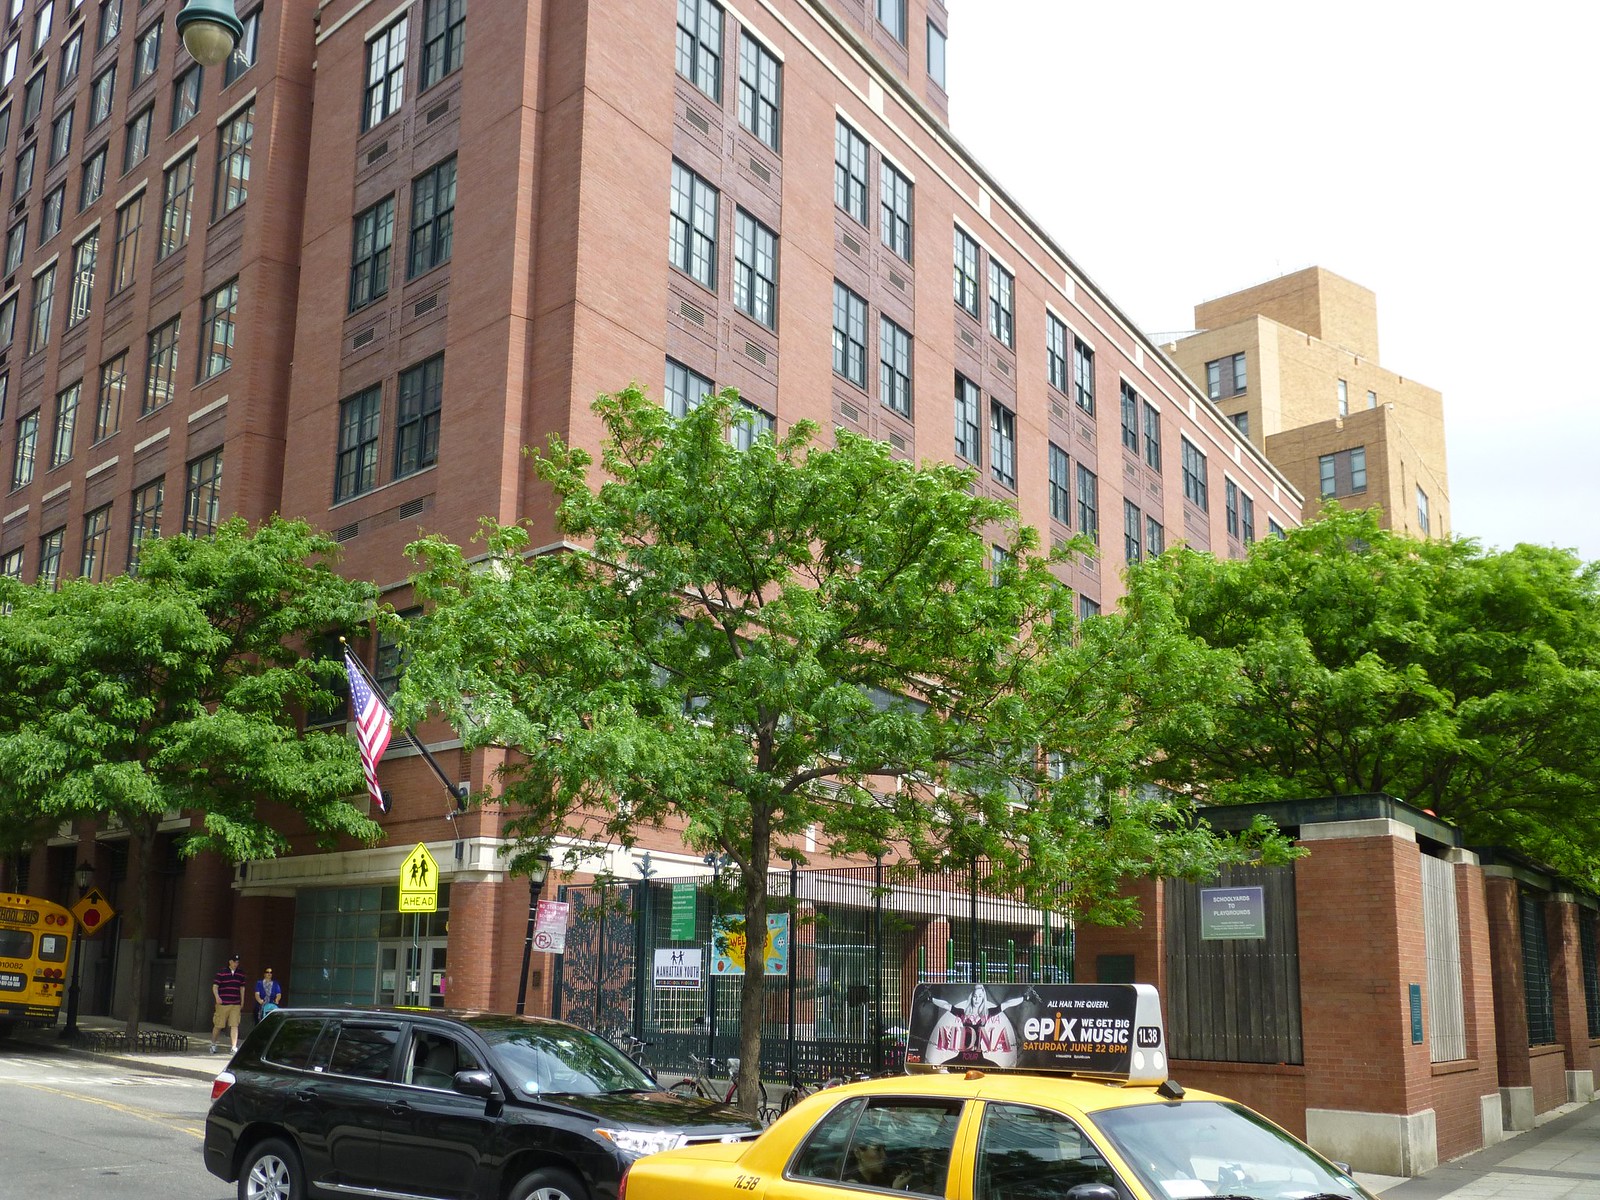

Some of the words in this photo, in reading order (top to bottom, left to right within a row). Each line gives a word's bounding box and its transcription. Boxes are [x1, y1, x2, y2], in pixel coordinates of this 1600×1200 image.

[403, 897, 434, 906] AHEAD
[0, 908, 18, 921] HOOL
[23, 910, 38, 922] BUS
[656, 966, 683, 978] MANHATTAN
[684, 966, 700, 978] YOUTH
[1047, 1000, 1059, 1008] ALL
[1086, 1001, 1110, 1009] QUEEN.
[1081, 1018, 1094, 1028] WE
[1096, 1019, 1114, 1028] GET
[1114, 1019, 1130, 1028] BIG
[937, 1026, 1012, 1053] MDNA
[1080, 1028, 1129, 1044] MUSIC
[1138, 1028, 1158, 1044] 1L38
[1023, 1042, 1069, 1052] SATURDAY,
[1070, 1043, 1093, 1053] JUNE
[1095, 1044, 1106, 1053] 22
[1108, 1044, 1128, 1054] 8PM
[733, 1175, 761, 1191] 1L38
